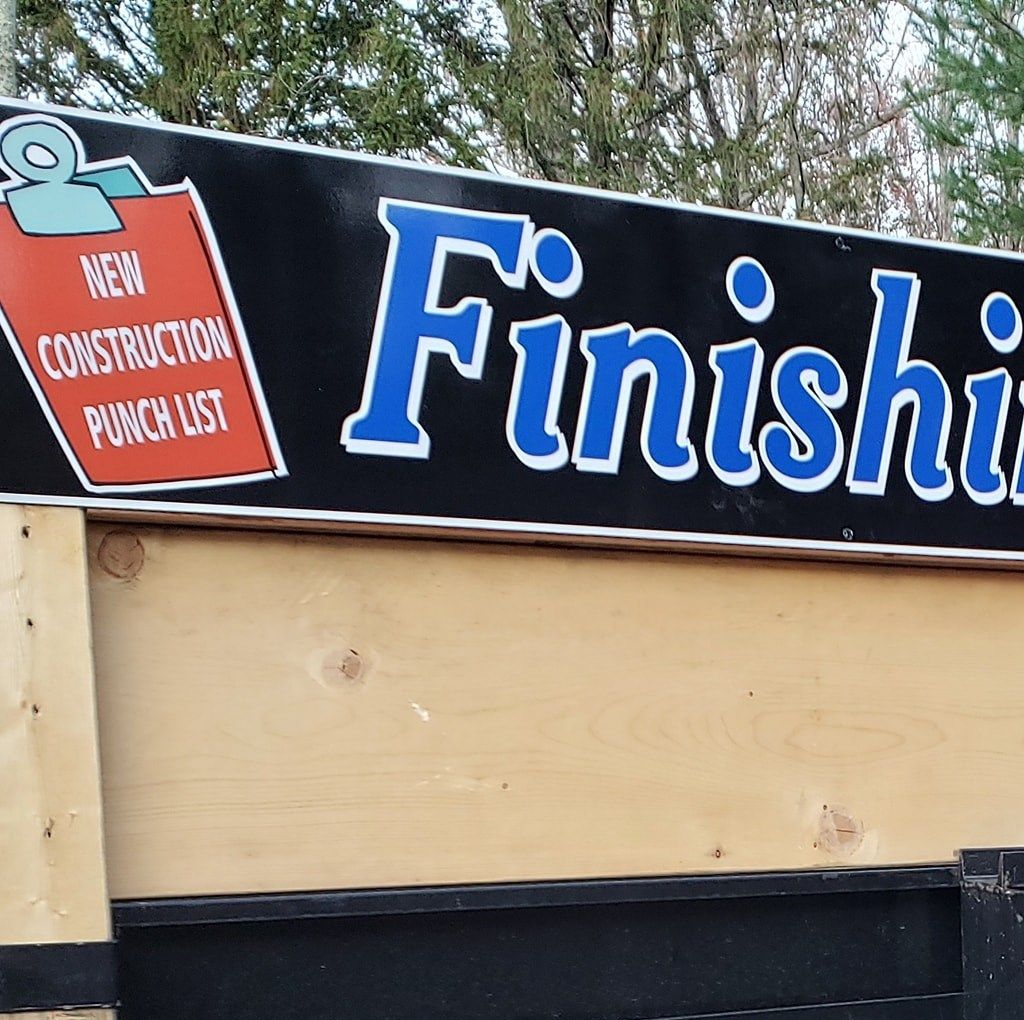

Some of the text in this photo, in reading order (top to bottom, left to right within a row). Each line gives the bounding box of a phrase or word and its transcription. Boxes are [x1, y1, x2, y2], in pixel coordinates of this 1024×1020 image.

[79, 250, 146, 300] NEW
[37, 315, 233, 381] CONSTRUCTION
[82, 389, 228, 449] PUNCH LIST
